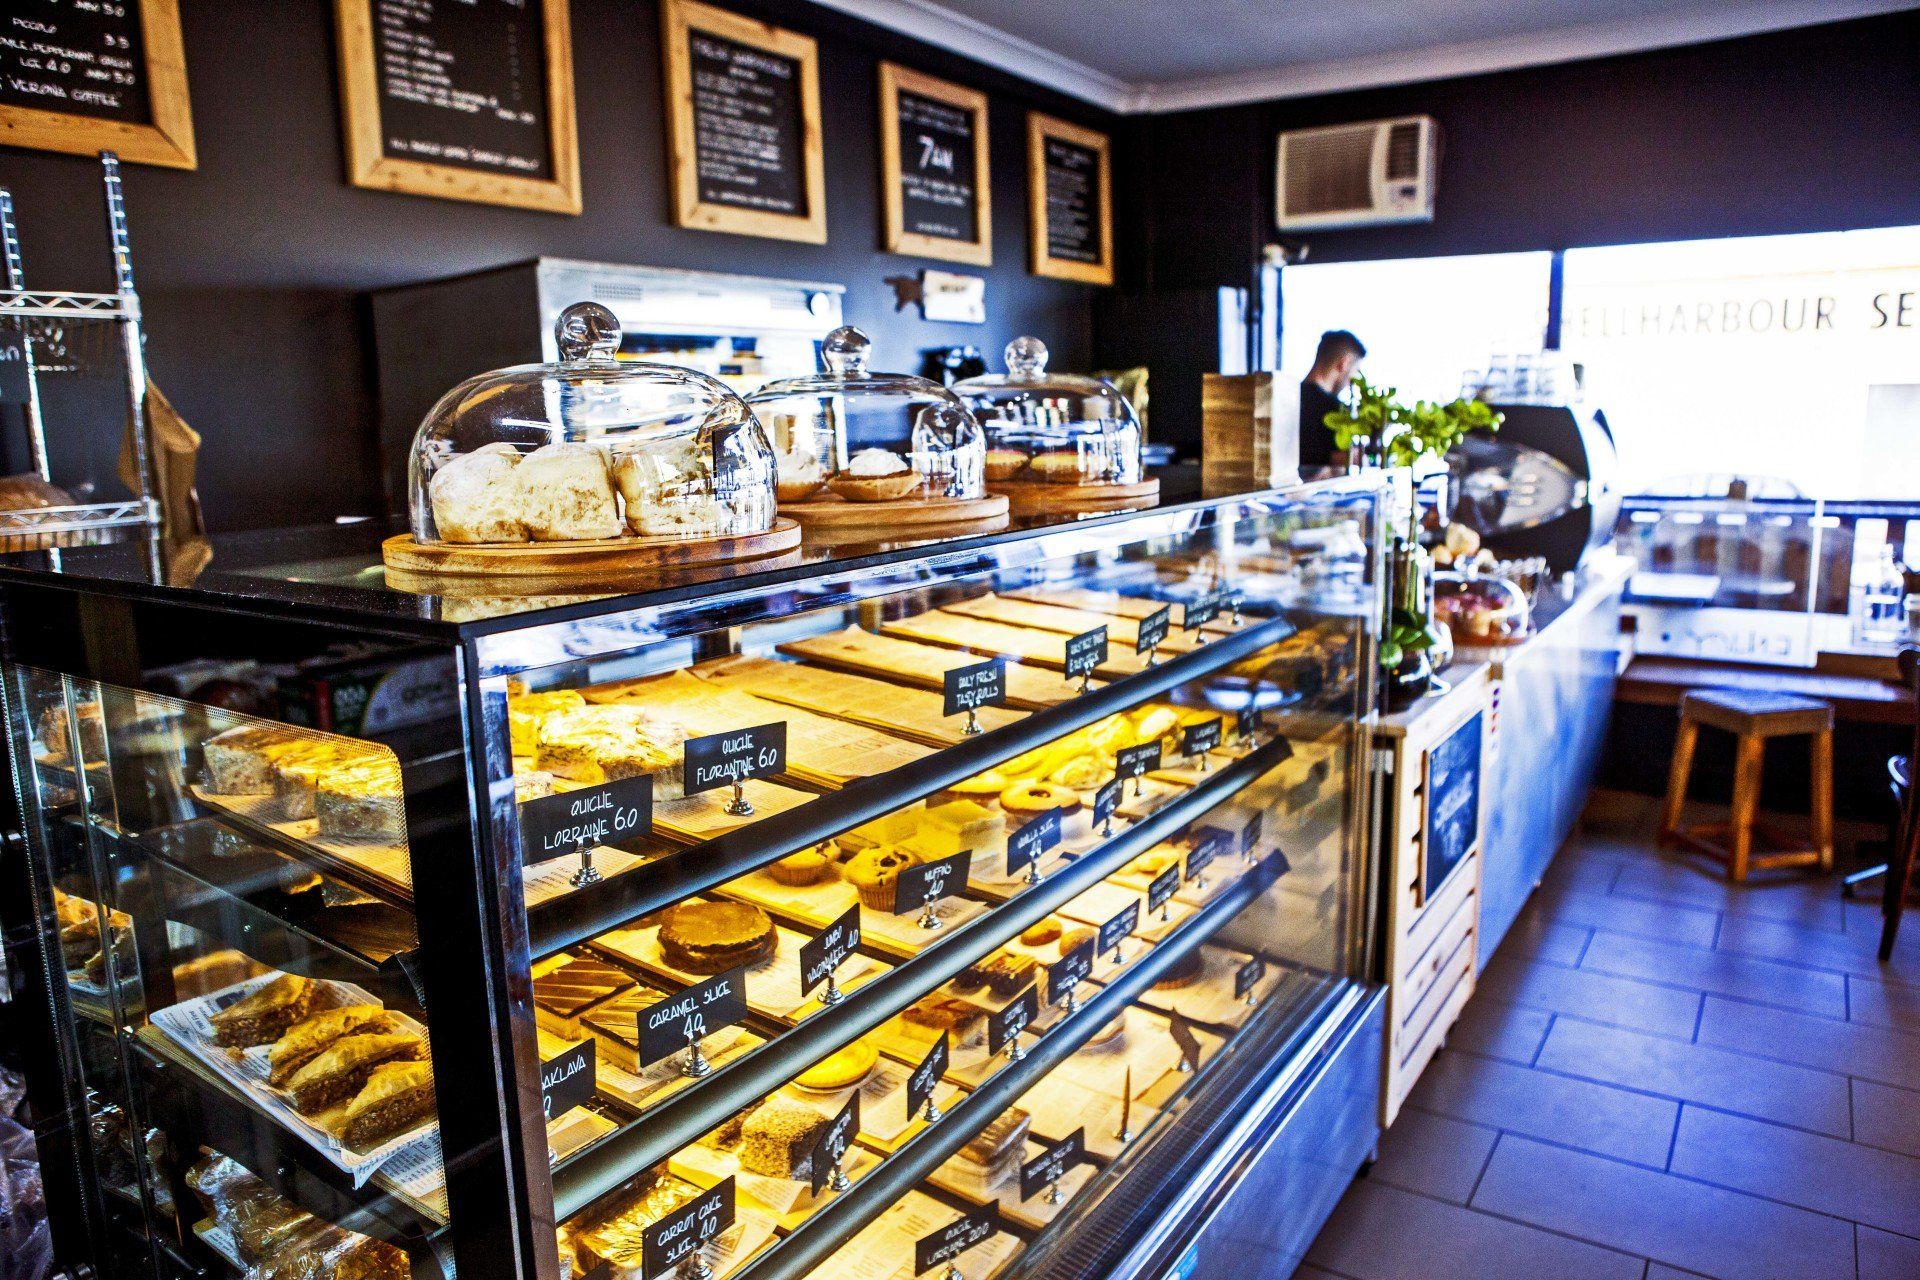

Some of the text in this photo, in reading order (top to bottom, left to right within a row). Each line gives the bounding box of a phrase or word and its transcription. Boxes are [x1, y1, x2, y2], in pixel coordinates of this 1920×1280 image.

[722, 733, 755, 757] QUICHE
[571, 790, 615, 817] QUICHE
[543, 818, 610, 850] LORRAINE
[648, 980, 732, 1030] CARAMEL SLICE
[541, 1054, 587, 1091] AKLAVA
[657, 1195, 723, 1247] CARROT CAKE
[665, 1236, 694, 1264] SLICE
